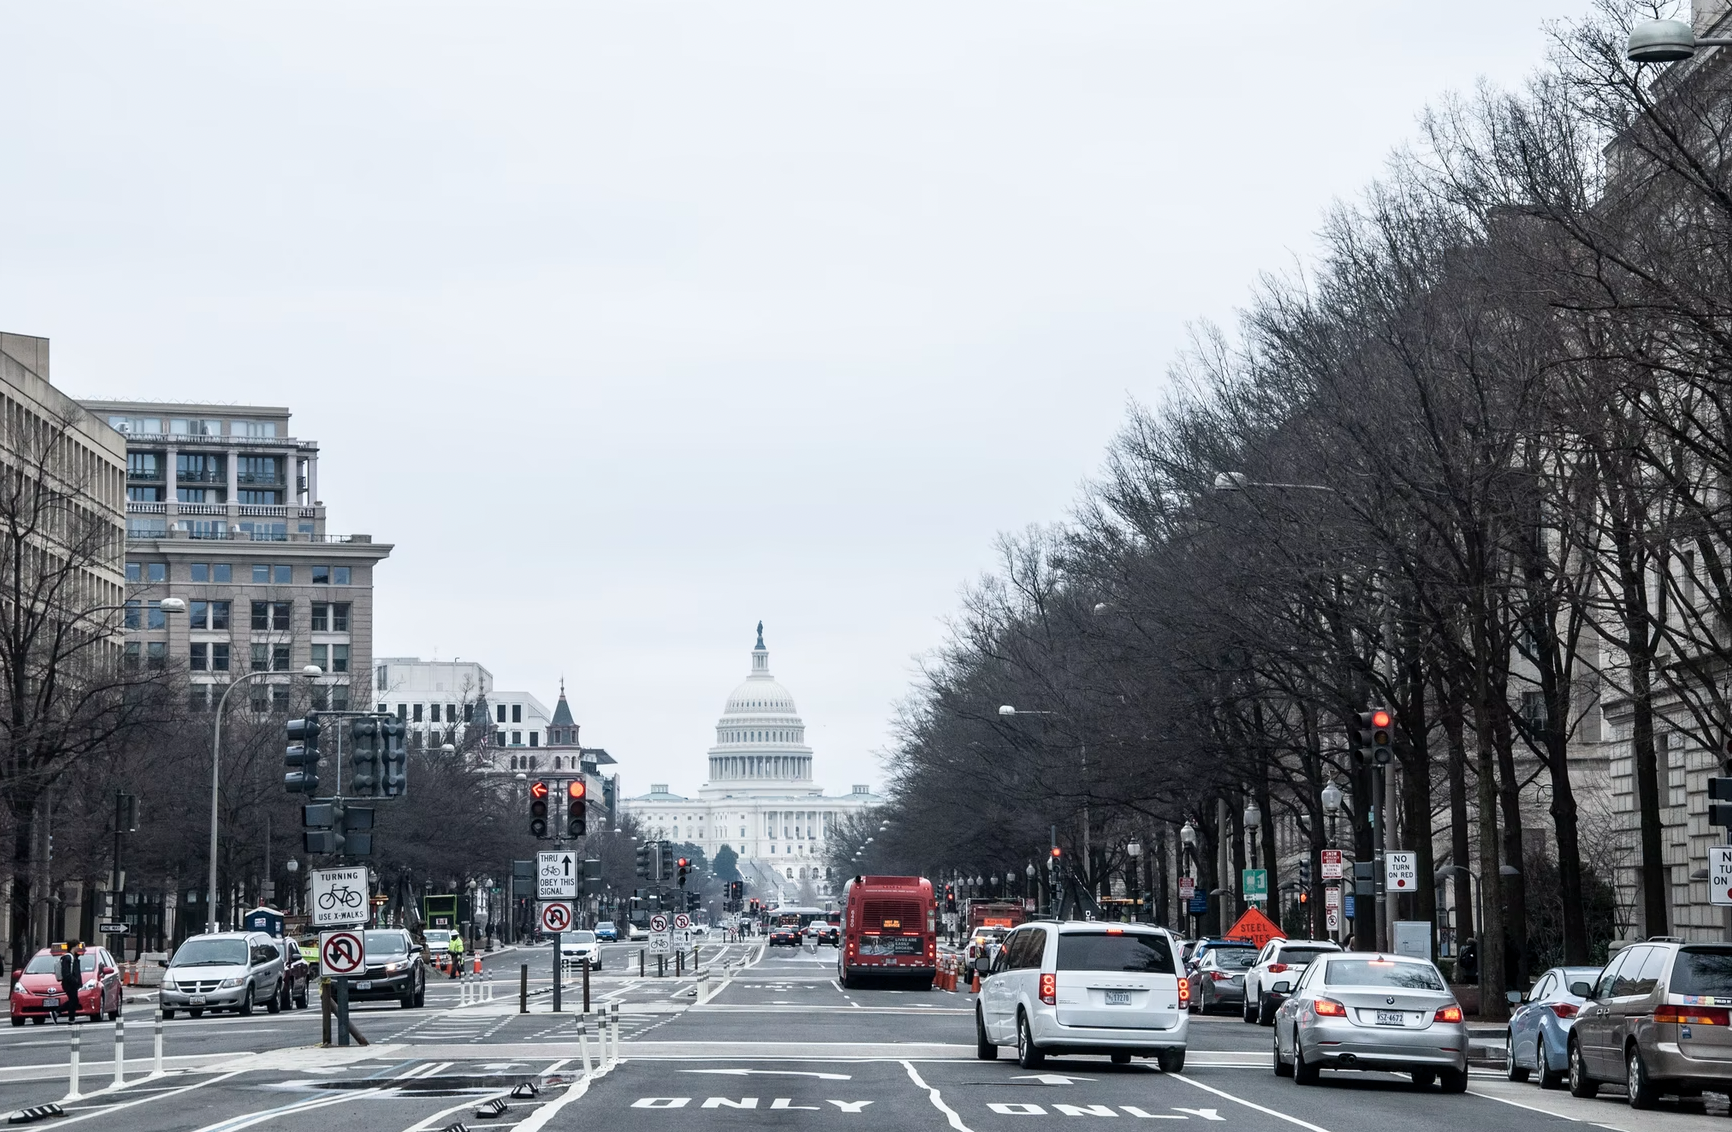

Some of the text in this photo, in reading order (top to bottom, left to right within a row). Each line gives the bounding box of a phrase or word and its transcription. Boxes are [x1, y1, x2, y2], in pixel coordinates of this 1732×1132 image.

[1394, 855, 1407, 863] NO
[1722, 852, 1732, 862] N
[1720, 864, 1732, 874] TU
[320, 872, 358, 880] TURNING
[540, 878, 574, 886] OBEY THIS
[1714, 876, 1728, 886] ON
[540, 888, 564, 896] SIGNAL
[318, 911, 364, 920] USE X-WALKS
[1240, 924, 1267, 932] STEEL
[630, 1098, 876, 1112] ONLY
[986, 1103, 1228, 1120] ONLY
